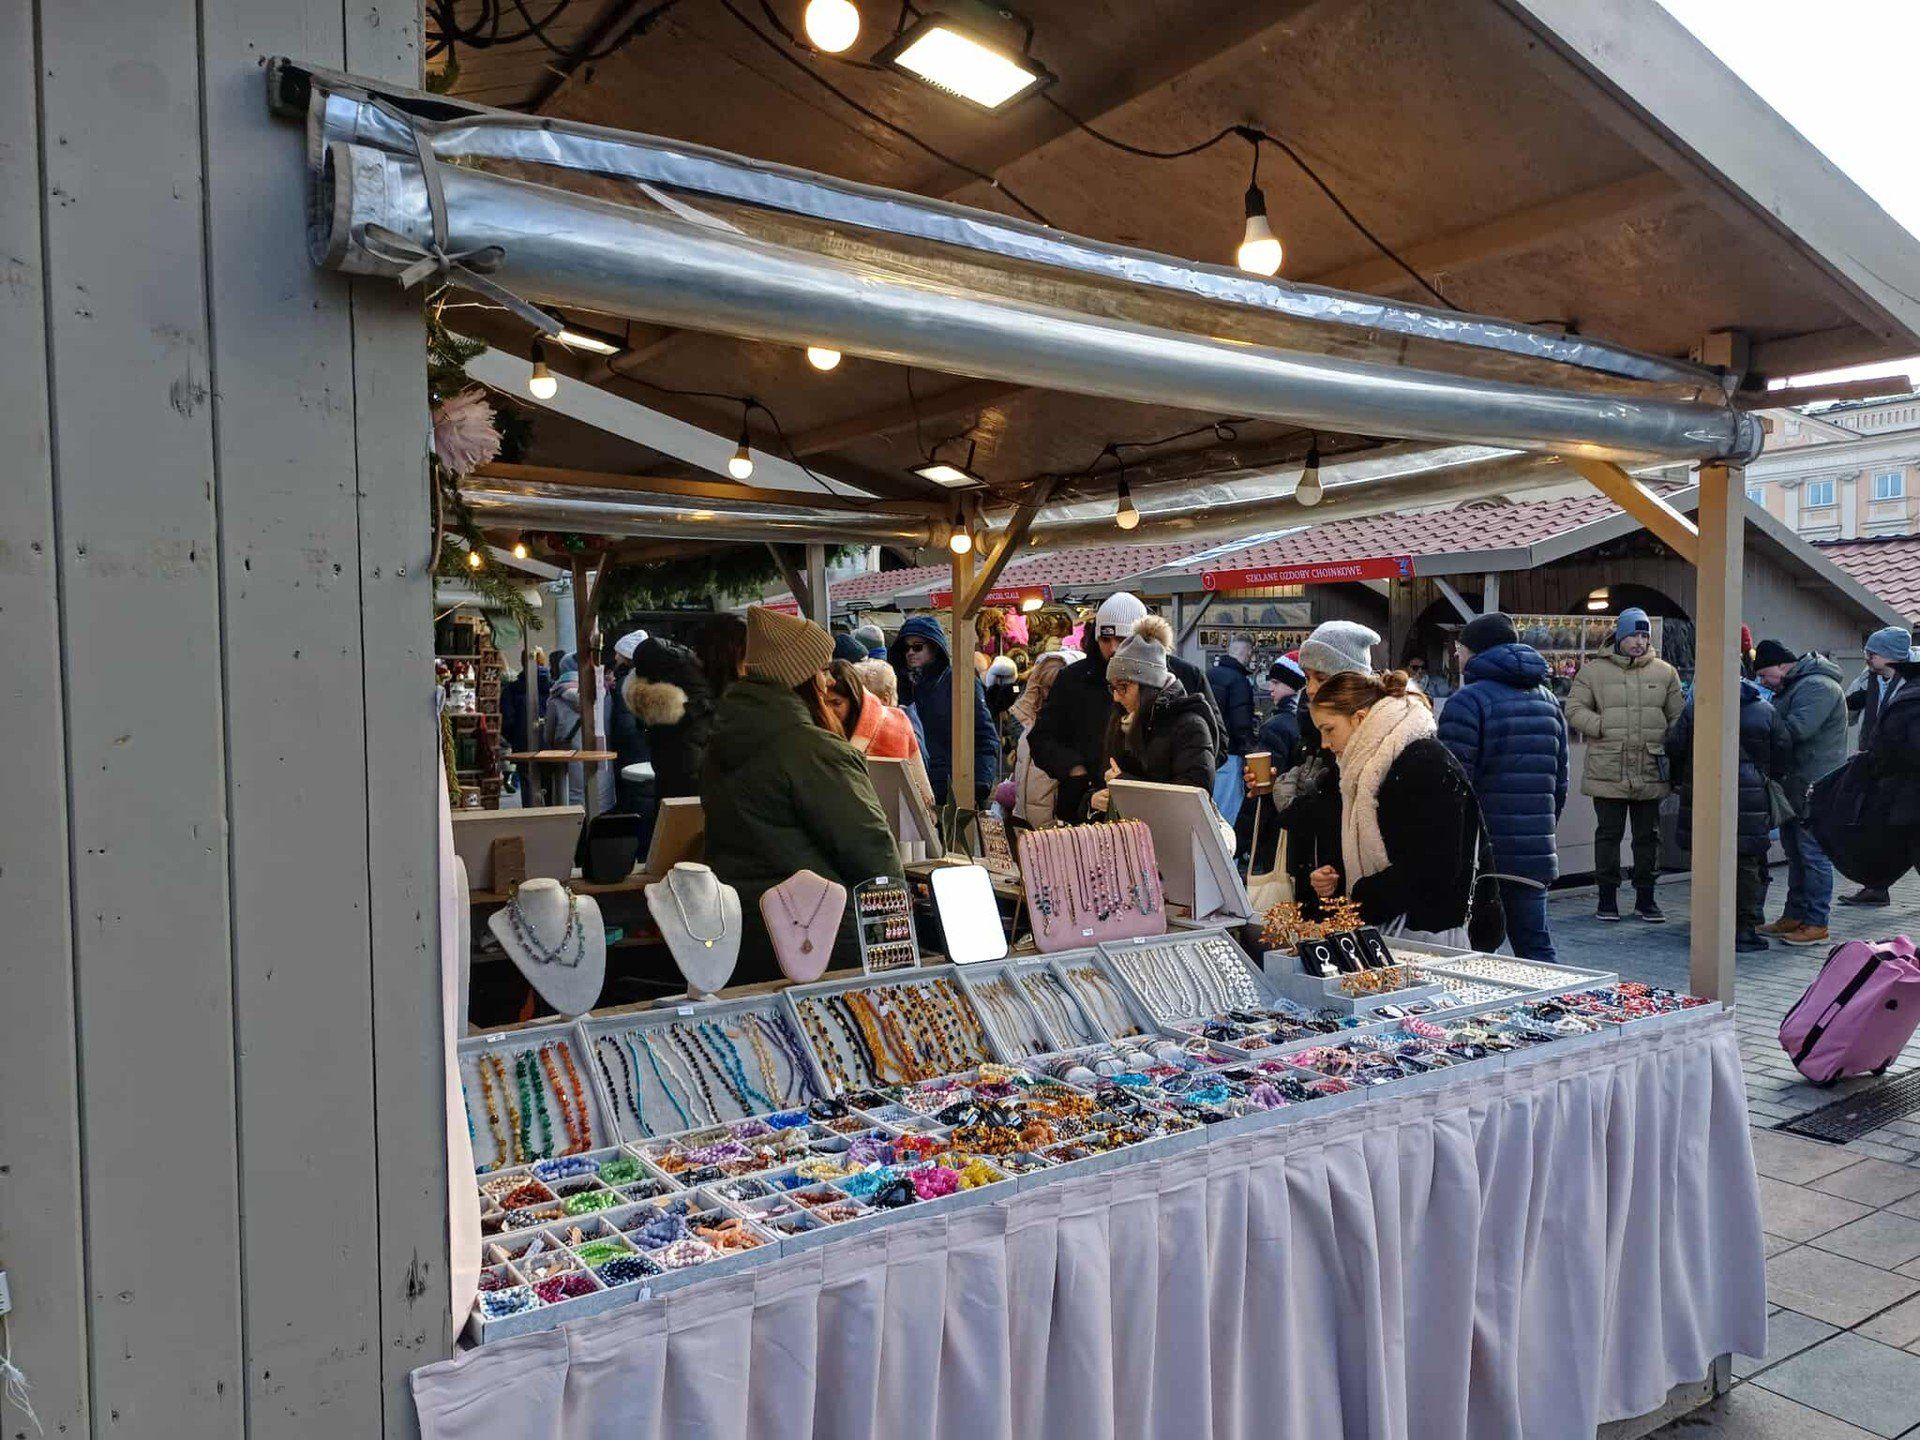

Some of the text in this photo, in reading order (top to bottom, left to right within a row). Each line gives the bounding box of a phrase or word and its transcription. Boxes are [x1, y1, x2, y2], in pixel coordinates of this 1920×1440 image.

[1245, 565, 1363, 583] SZKLANE OZDOBY CHOINKOWE
